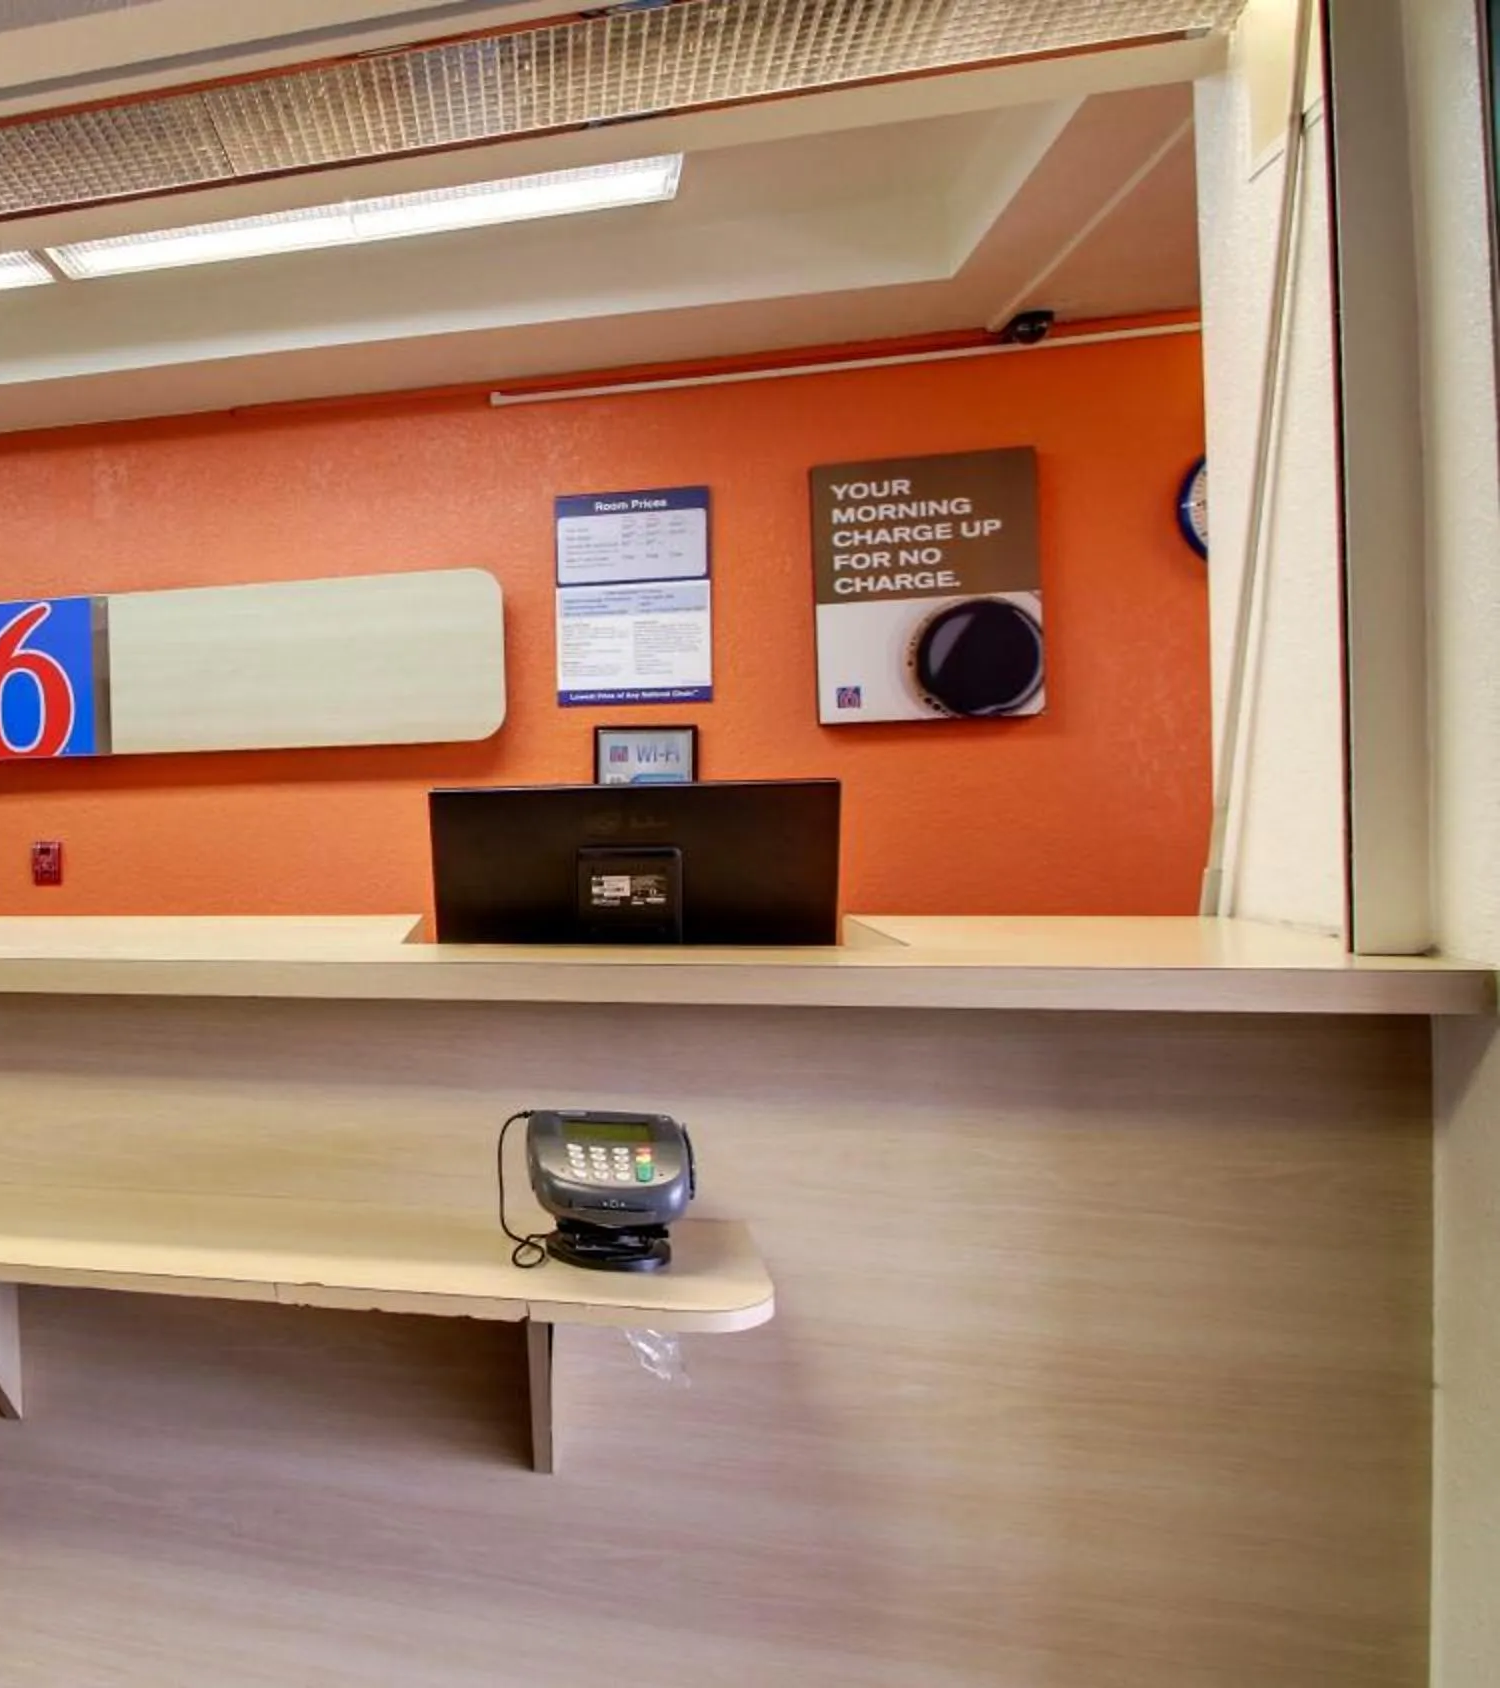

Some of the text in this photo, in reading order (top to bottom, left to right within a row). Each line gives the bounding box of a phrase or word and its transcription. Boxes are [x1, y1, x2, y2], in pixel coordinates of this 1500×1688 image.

[830, 479, 911, 500] YOUR
[595, 499, 667, 512] Room Prices
[831, 498, 972, 524] MORNING
[832, 519, 1002, 548] CHARGE UP
[833, 547, 942, 571] FOR NO
[833, 570, 962, 594] CHARGE.
